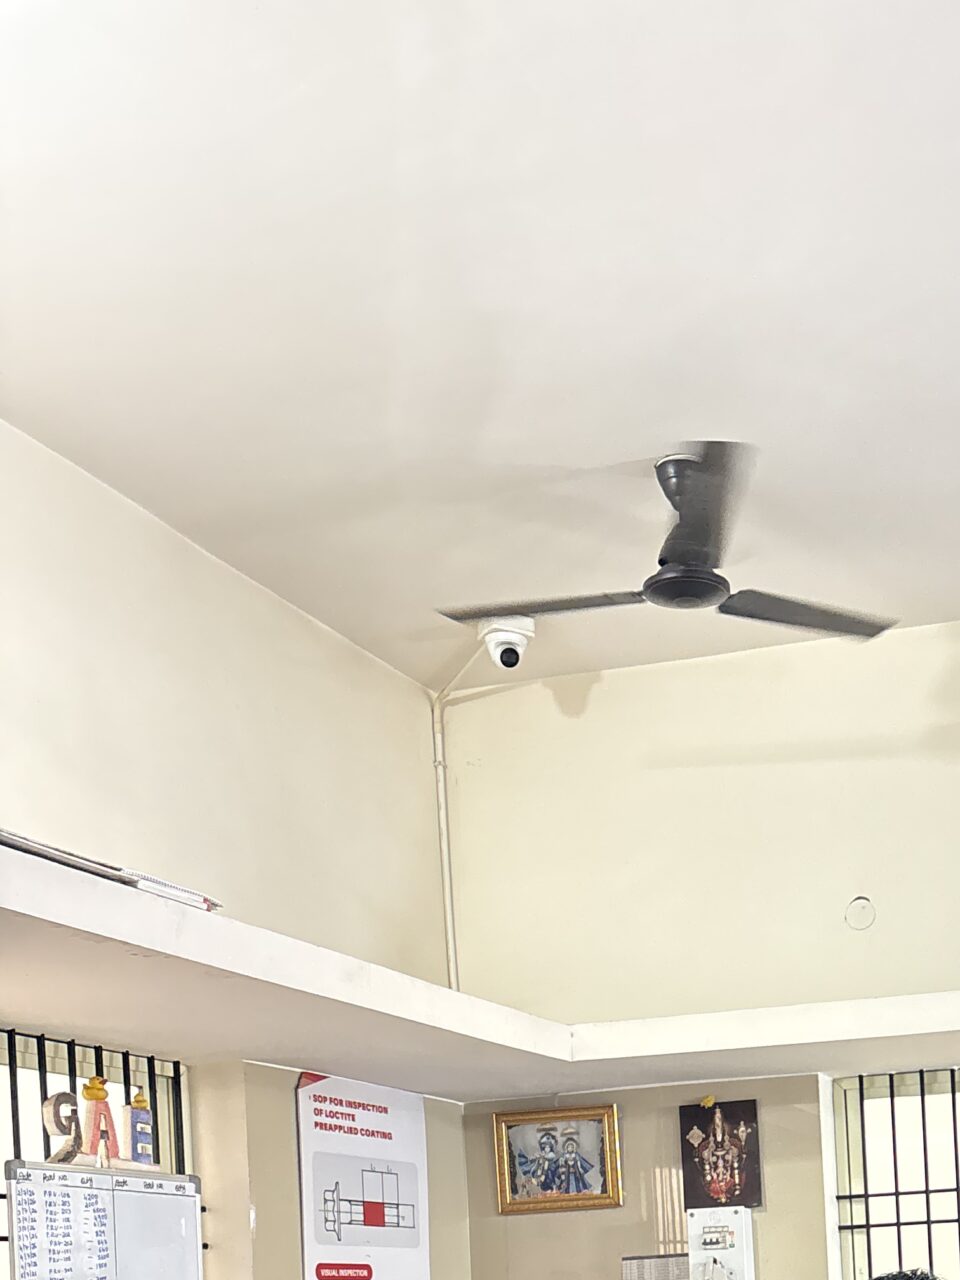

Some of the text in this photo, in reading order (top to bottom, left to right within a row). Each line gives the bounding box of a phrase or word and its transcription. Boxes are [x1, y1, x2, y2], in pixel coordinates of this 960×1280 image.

[312, 1094, 389, 1114] SOP FOR INSPECTION
[313, 1107, 356, 1122] OF LOCTITE
[314, 1121, 393, 1141] PREAPPLIED COATING
[320, 1268, 369, 1277] VISUAL INSPECTION
